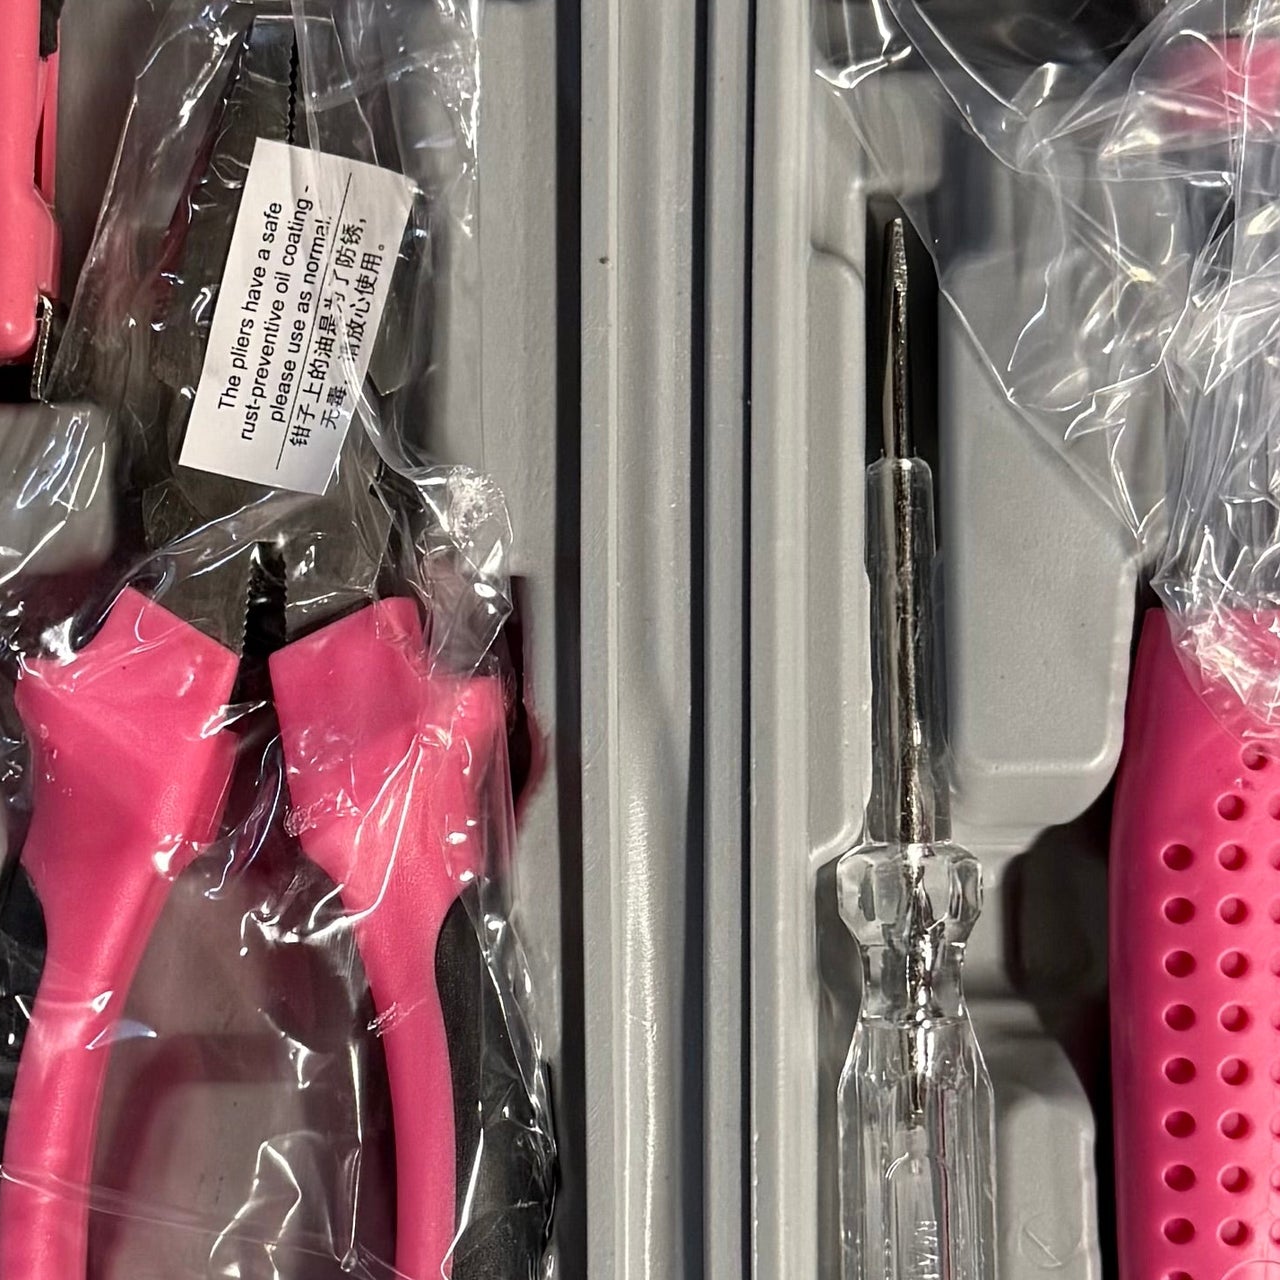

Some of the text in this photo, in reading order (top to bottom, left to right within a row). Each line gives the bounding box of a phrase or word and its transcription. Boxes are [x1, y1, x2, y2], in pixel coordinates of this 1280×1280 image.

[274, 271, 291, 294] oil
[282, 198, 313, 266] coating
[218, 202, 282, 409] The pliers have a safe
[241, 299, 285, 440] rust-preventive
[270, 360, 296, 423] please
[288, 320, 306, 353] use
[297, 291, 312, 314] as
